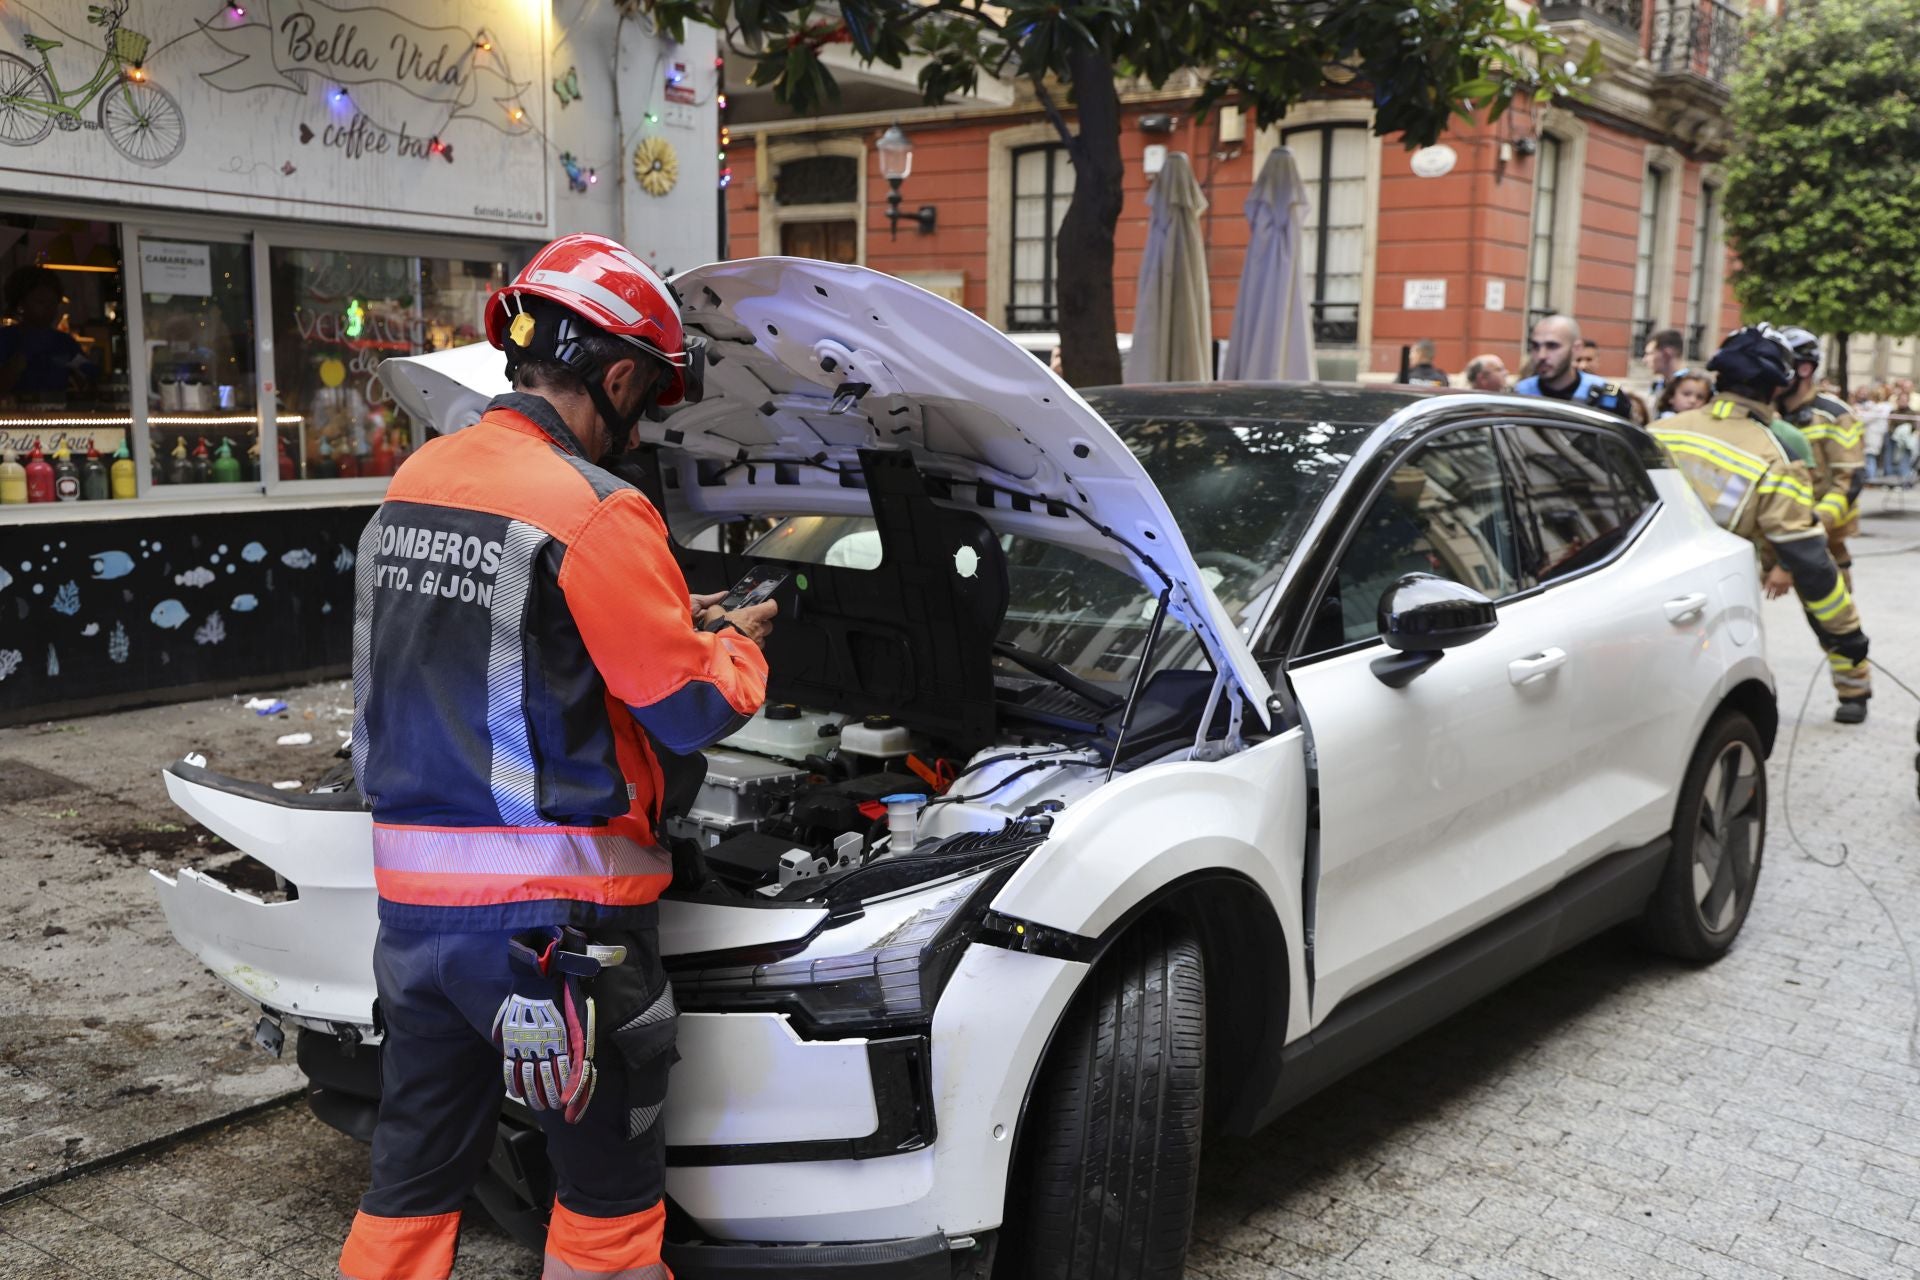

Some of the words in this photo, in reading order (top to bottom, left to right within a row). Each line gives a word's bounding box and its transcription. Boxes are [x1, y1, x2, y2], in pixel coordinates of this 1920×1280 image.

[281, 13, 378, 73] Bella
[390, 34, 468, 86] Vida
[322, 113, 391, 159] coffee
[375, 563, 413, 592] YTO.
[420, 571, 494, 609] GIJÓN
